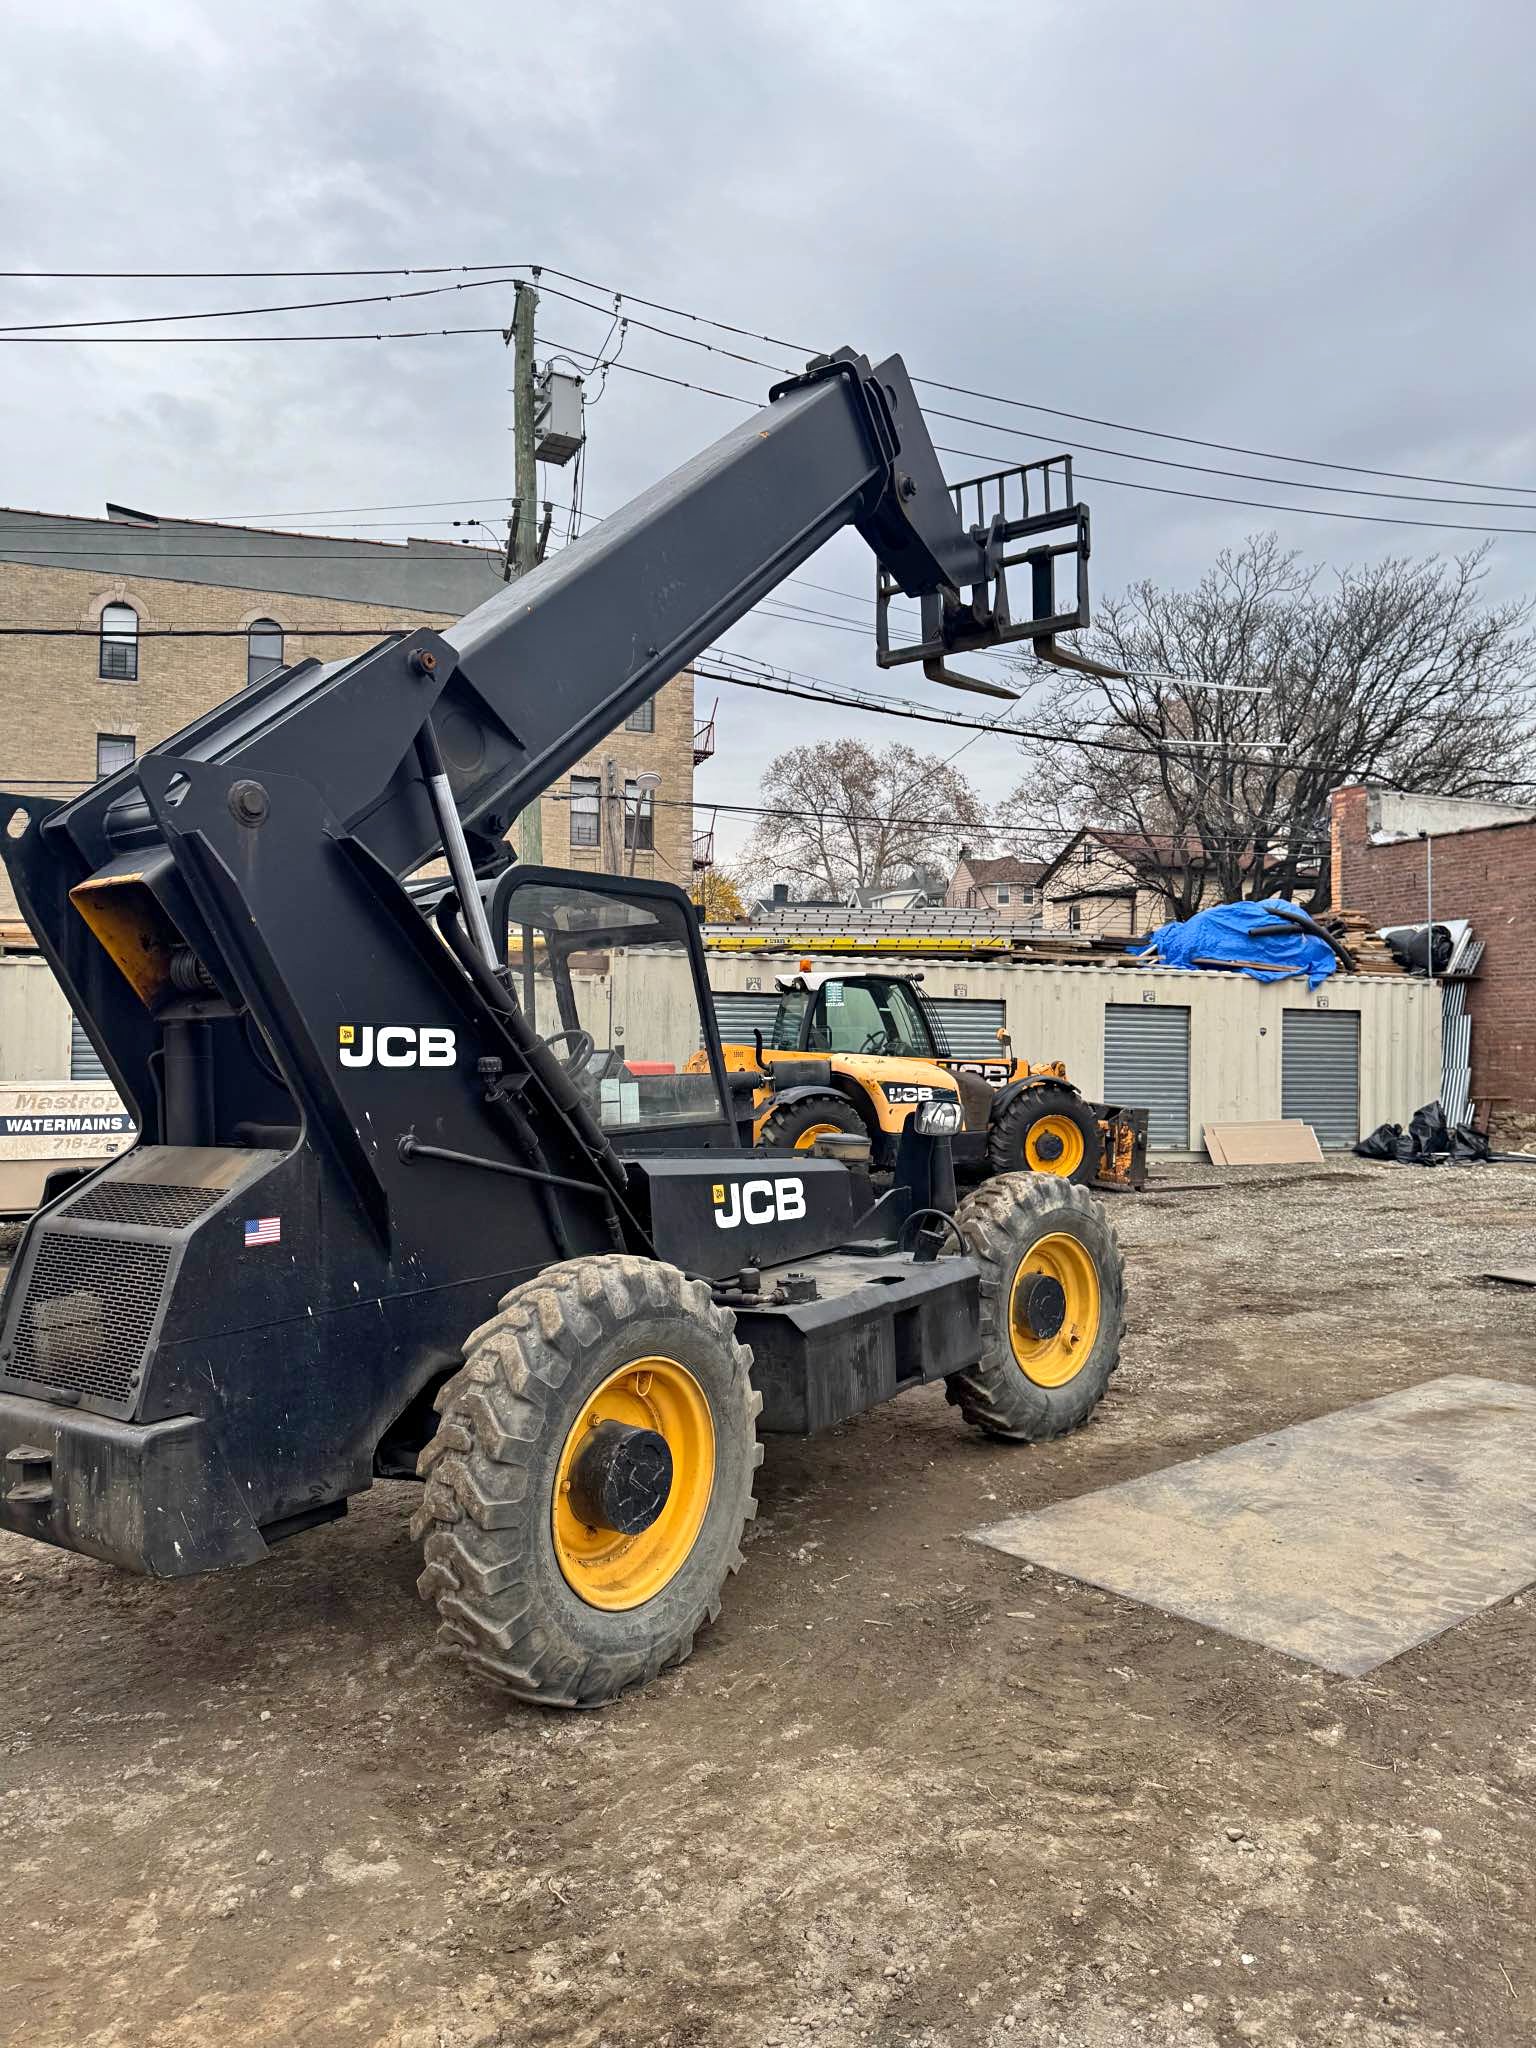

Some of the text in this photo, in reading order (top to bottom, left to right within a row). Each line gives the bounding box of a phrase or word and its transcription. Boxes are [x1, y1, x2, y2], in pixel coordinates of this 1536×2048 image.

[340, 1026, 457, 1067] JCB
[889, 1087, 933, 1102] JCB
[6, 1117, 122, 1132] WATERMAINS
[714, 1178, 806, 1228] JCB
